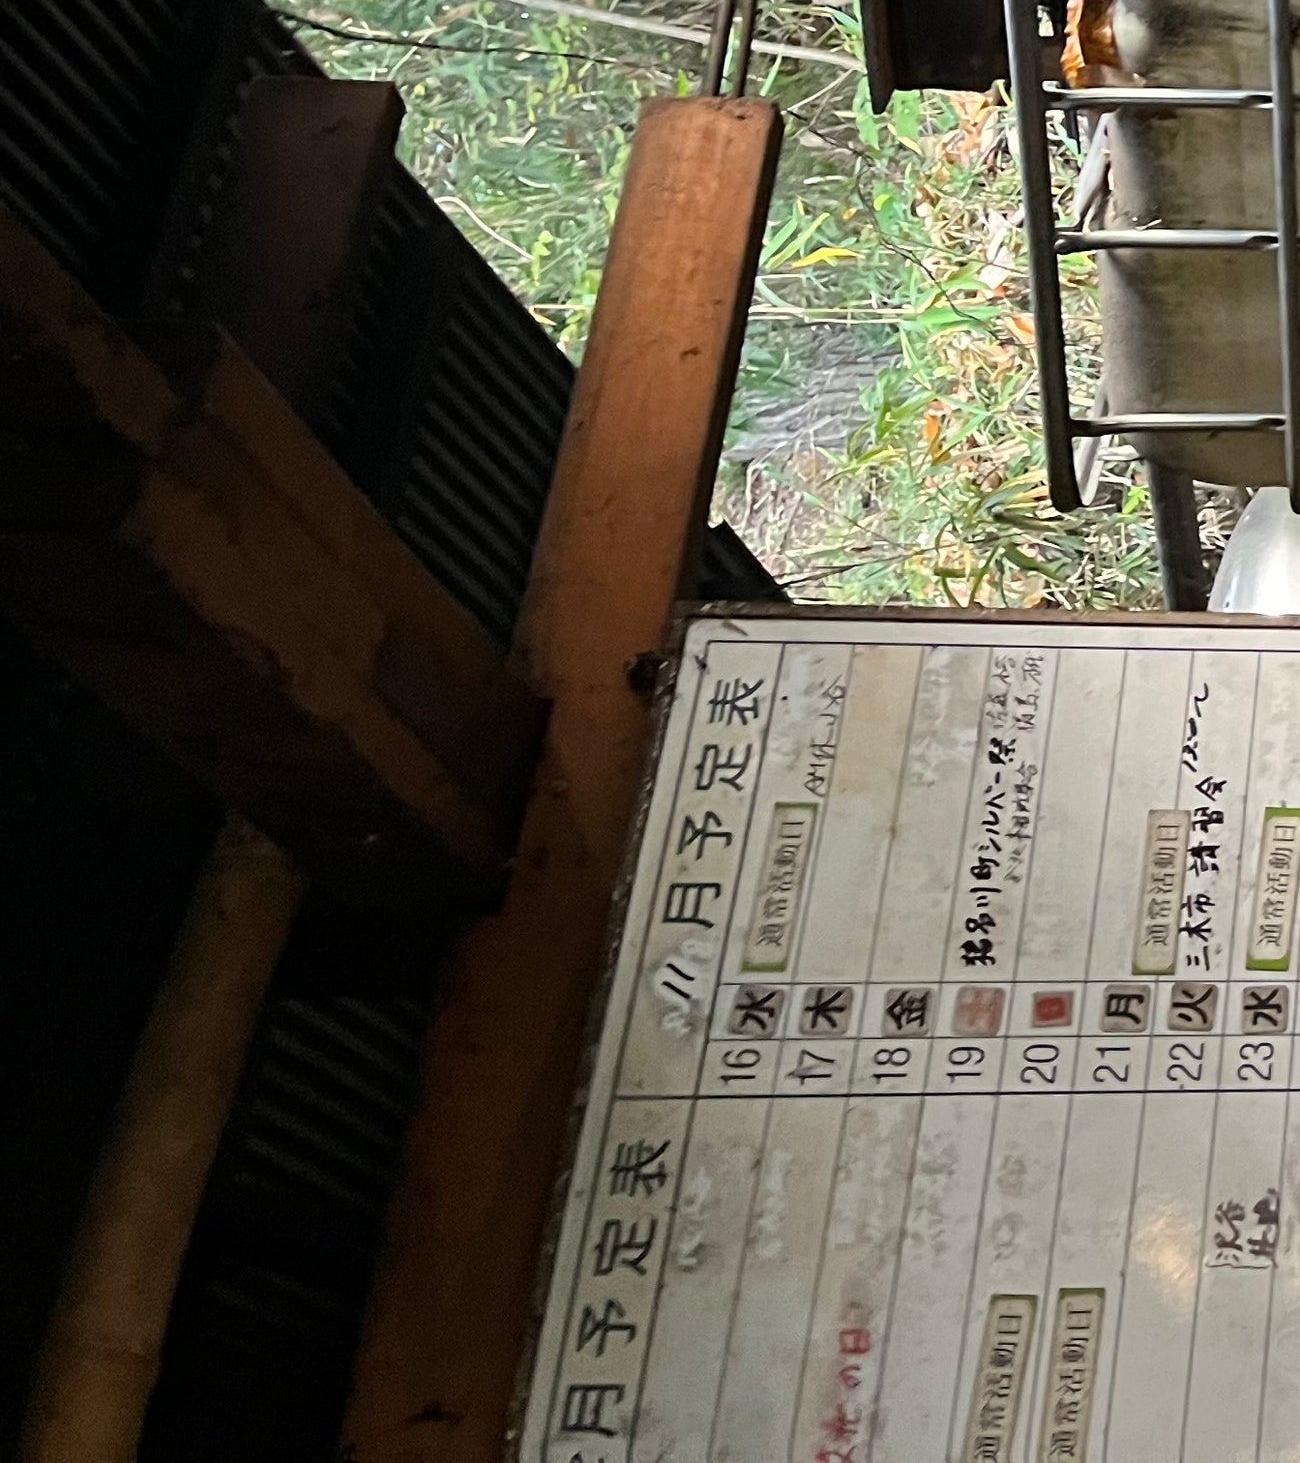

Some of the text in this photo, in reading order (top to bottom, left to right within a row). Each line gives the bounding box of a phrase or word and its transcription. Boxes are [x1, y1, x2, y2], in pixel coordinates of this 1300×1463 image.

[719, 820, 805, 1085] 16 水 通常活動日
[1094, 823, 1181, 1083] 21 月 通常活動日
[1177, 892, 1216, 971] 三木市
[1239, 823, 1298, 1082] 23 水 通常活動日
[793, 987, 848, 1084] 17 木
[871, 989, 929, 1085] 18 金
[946, 1044, 985, 1084] 19
[1021, 1043, 1059, 1083] 20
[1169, 985, 1213, 1083] 22 火
[560, 1139, 671, 1463] 月予定表
[1050, 1306, 1093, 1458] 通常活動日
